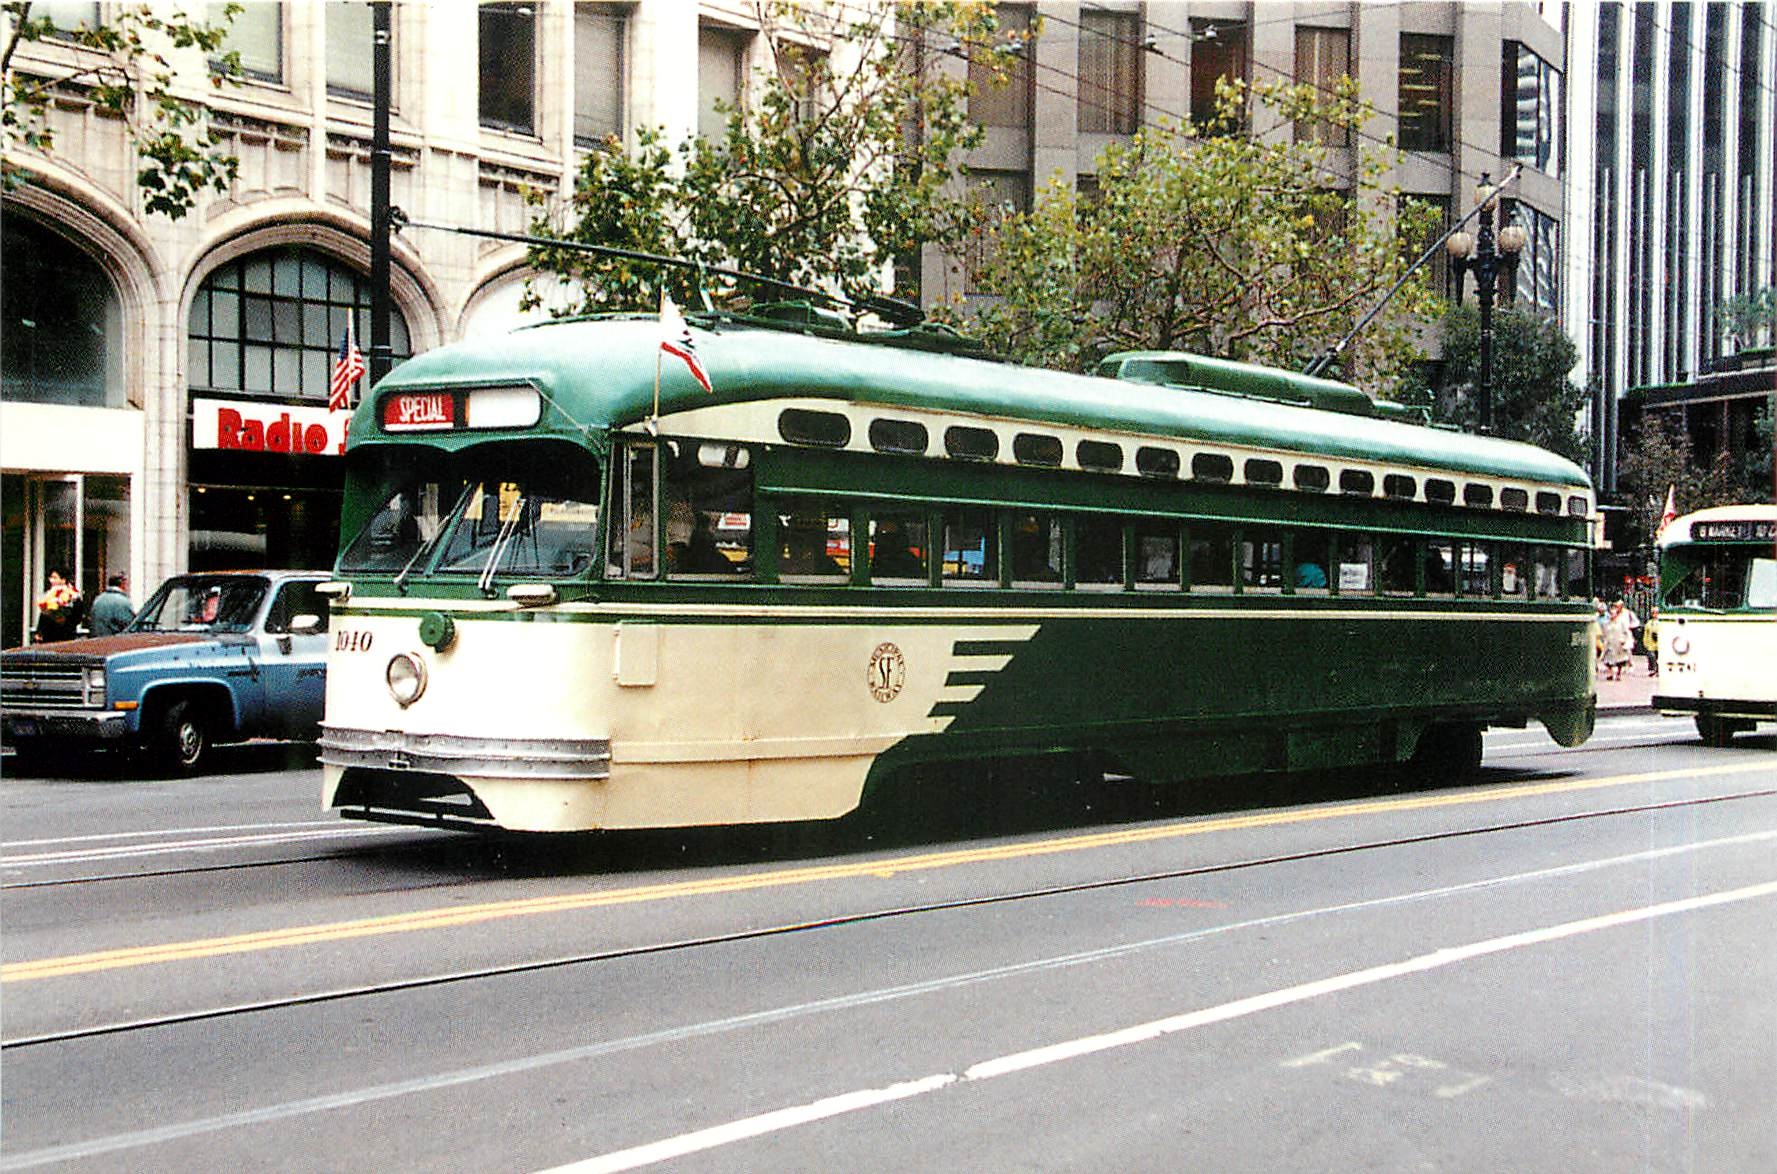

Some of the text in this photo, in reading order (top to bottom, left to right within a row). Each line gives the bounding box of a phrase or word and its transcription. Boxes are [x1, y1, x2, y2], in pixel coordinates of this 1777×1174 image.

[400, 395, 447, 422] SPECIAL
[218, 408, 328, 454] Radio
[335, 630, 373, 652] 1040
